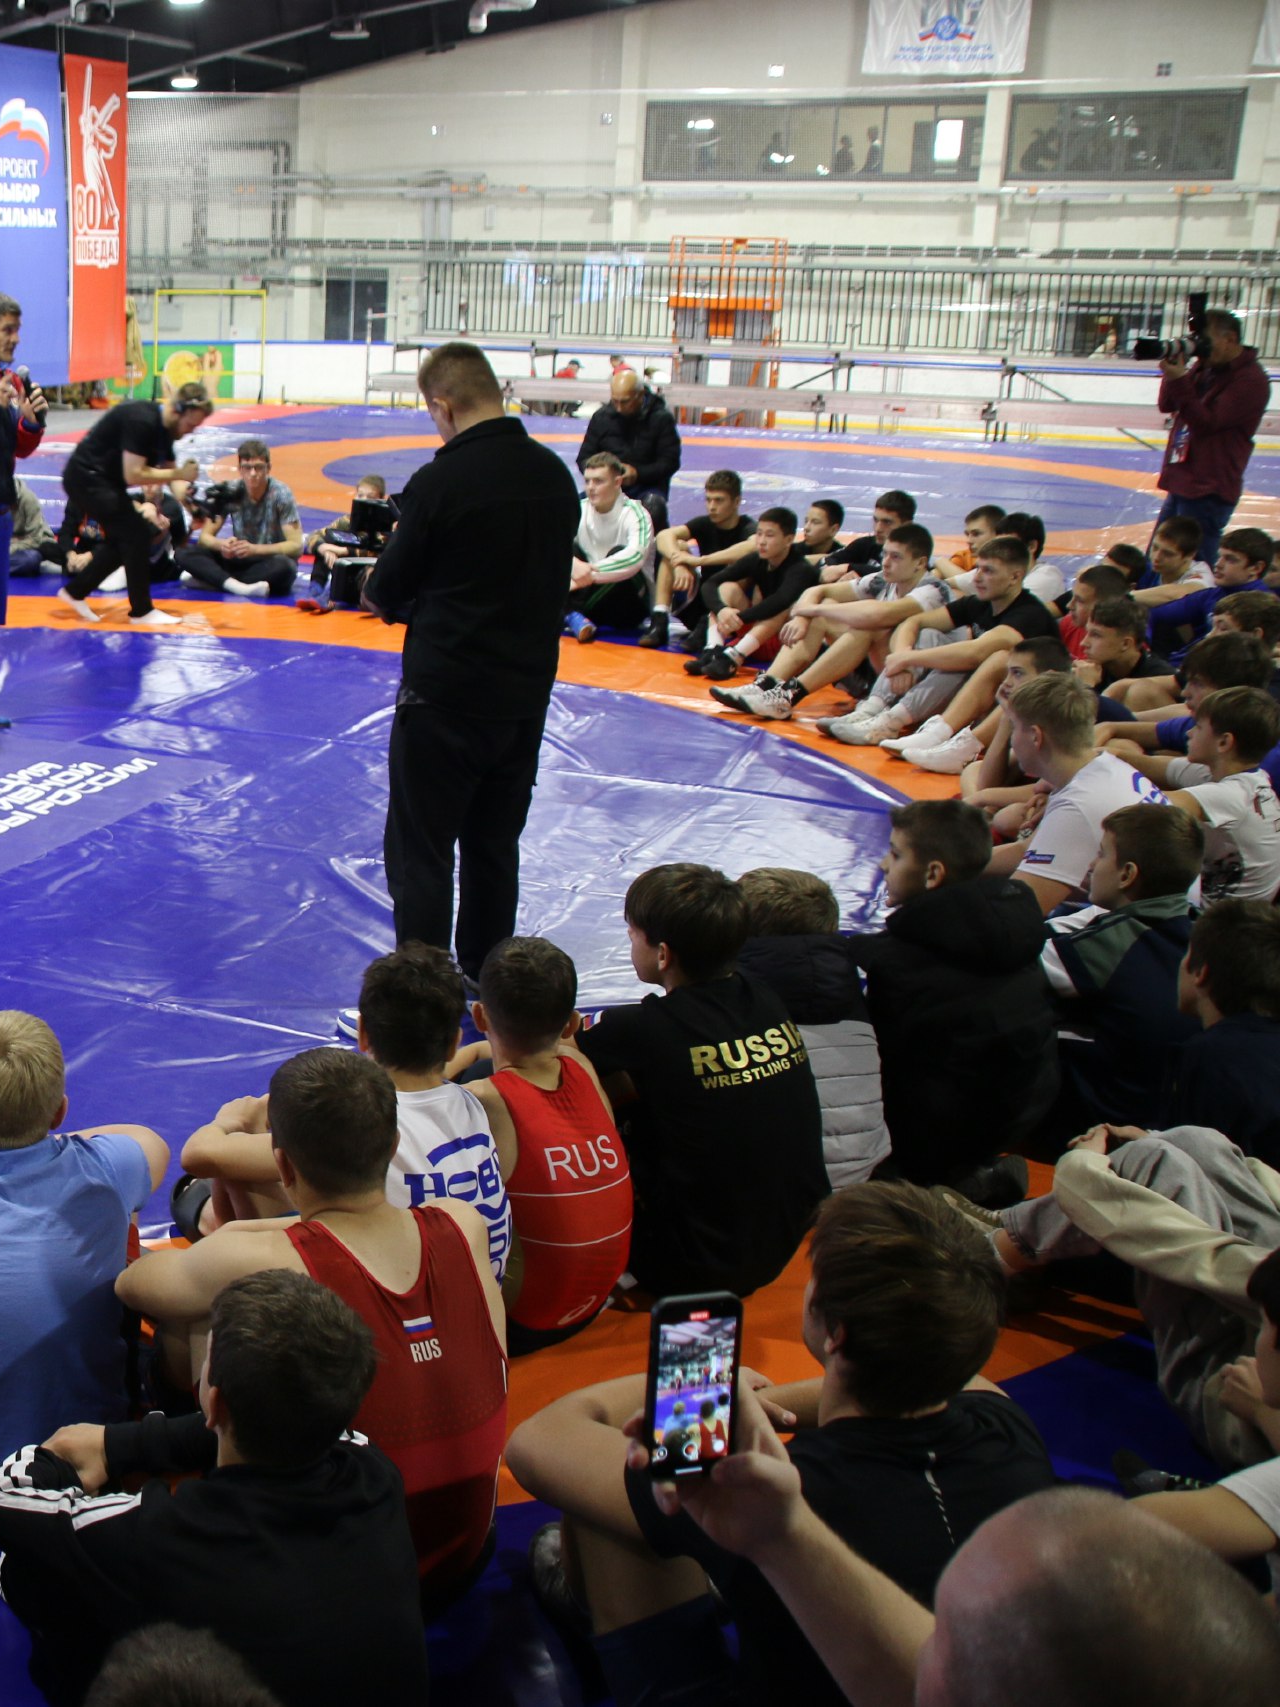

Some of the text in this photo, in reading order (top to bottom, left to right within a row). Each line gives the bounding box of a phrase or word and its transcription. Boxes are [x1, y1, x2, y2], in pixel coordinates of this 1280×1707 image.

[76, 239, 119, 262] ПОБЕДА!
[24, 757, 158, 815] РОССИИ
[701, 1058, 791, 1090] WRESTLING
[544, 1135, 619, 1181] RUS
[409, 1338, 442, 1363] RUS
